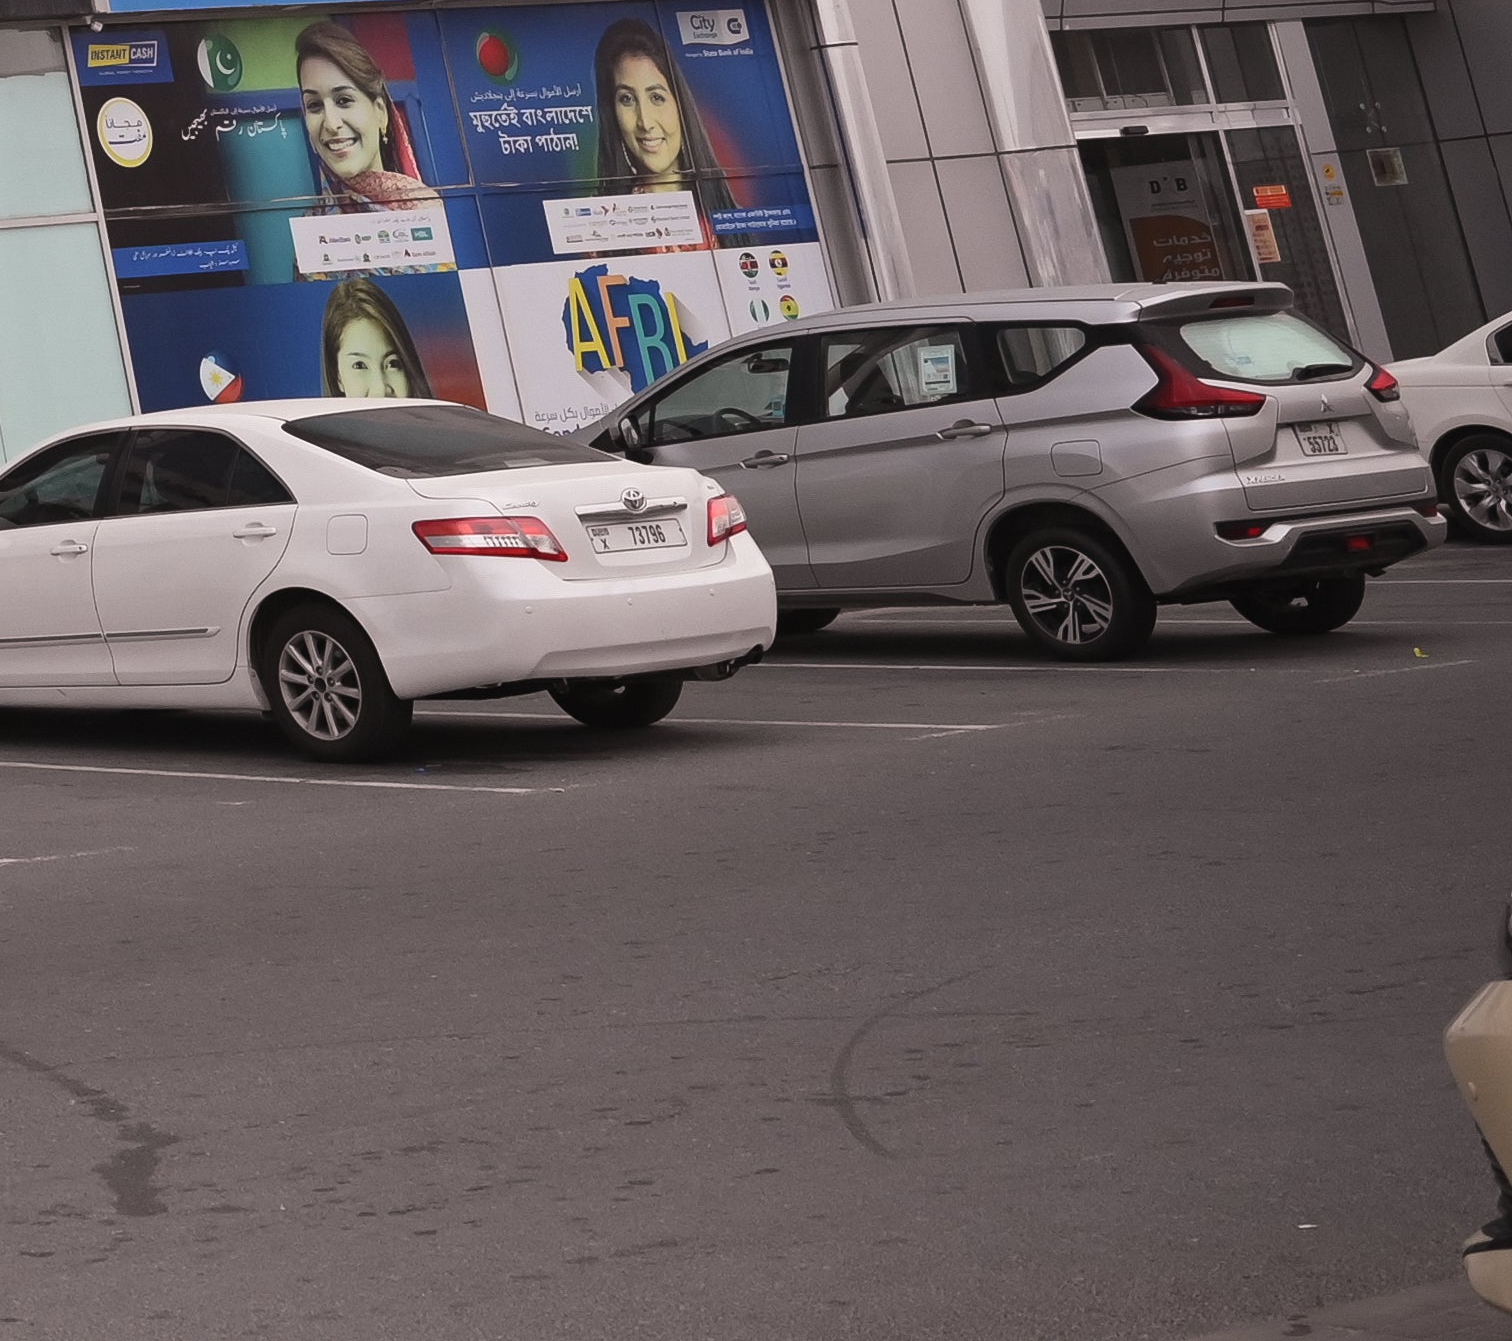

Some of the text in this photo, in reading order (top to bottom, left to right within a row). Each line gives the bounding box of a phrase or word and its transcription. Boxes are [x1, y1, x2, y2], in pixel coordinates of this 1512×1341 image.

[689, 14, 716, 33] City
[89, 45, 155, 61] INSTANT CASH
[627, 523, 668, 547] 73796
